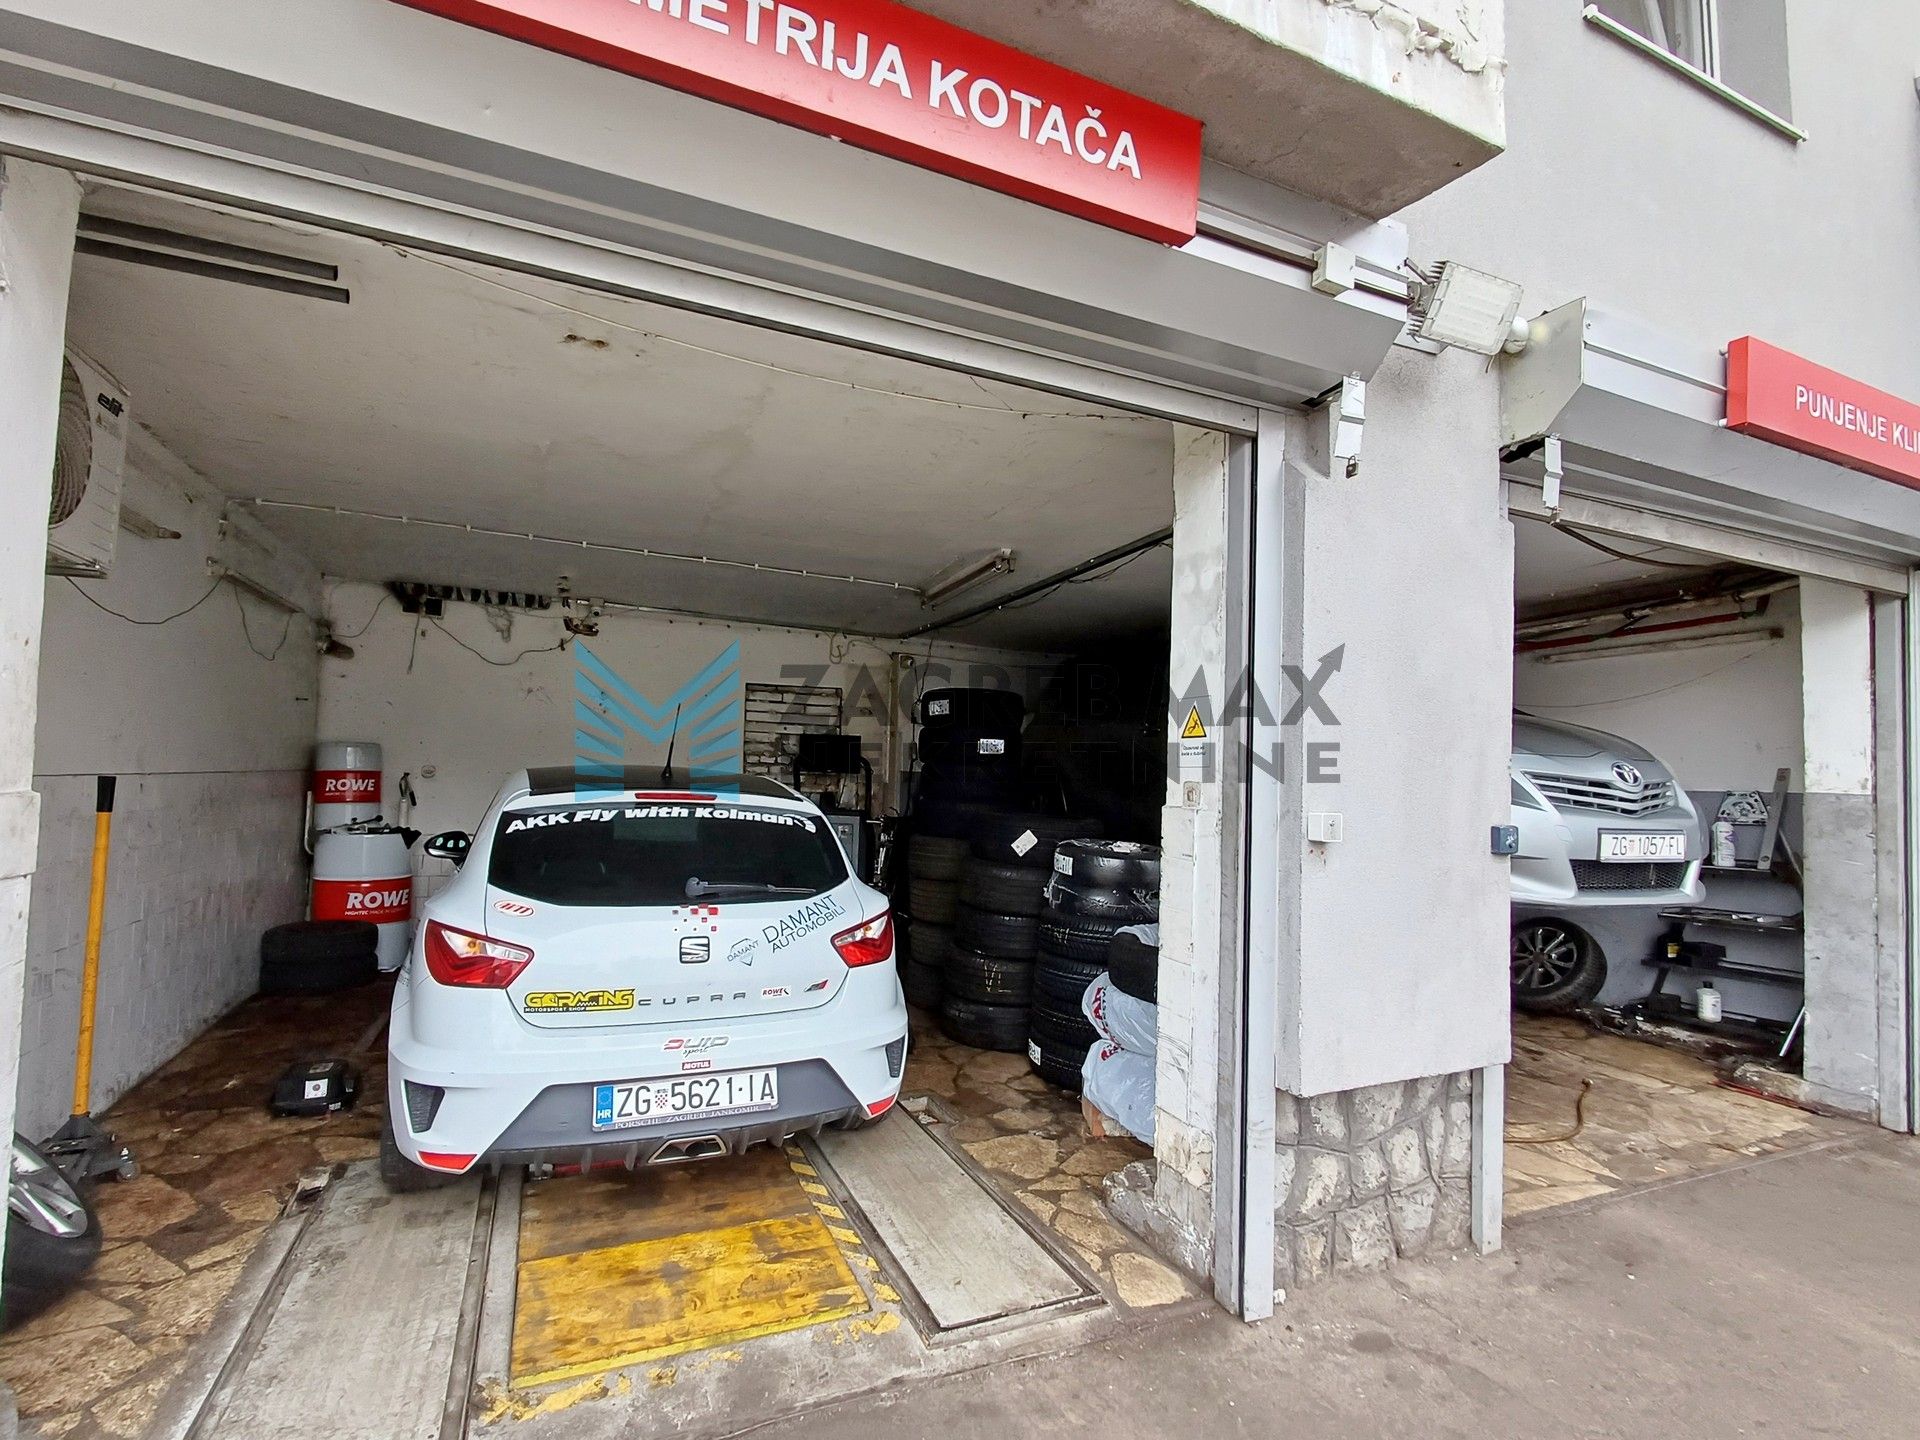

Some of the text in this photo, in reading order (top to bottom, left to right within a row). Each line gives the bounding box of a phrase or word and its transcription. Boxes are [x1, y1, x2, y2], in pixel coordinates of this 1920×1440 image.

[928, 59, 1144, 180] KOTAČA
[1795, 384, 1920, 455] PUNJENJE KLI
[325, 778, 376, 792] ROWE
[505, 811, 569, 834] AKK
[573, 807, 617, 822] Fly
[625, 805, 689, 819] with
[1612, 836, 1628, 856] ZG
[346, 888, 411, 910] ROWE
[762, 894, 838, 944] DAMANT
[771, 905, 847, 954] AUTOMOBILI
[726, 939, 760, 962] DAMANT
[638, 992, 746, 1006] CUPRA
[762, 987, 785, 997] ROWE
[683, 1061, 710, 1070] MOTUL
[617, 1085, 651, 1118] ZG
[597, 1109, 612, 1120] HR
[615, 1105, 760, 1130] PORSCHE ZAGREB JANKOMIR
